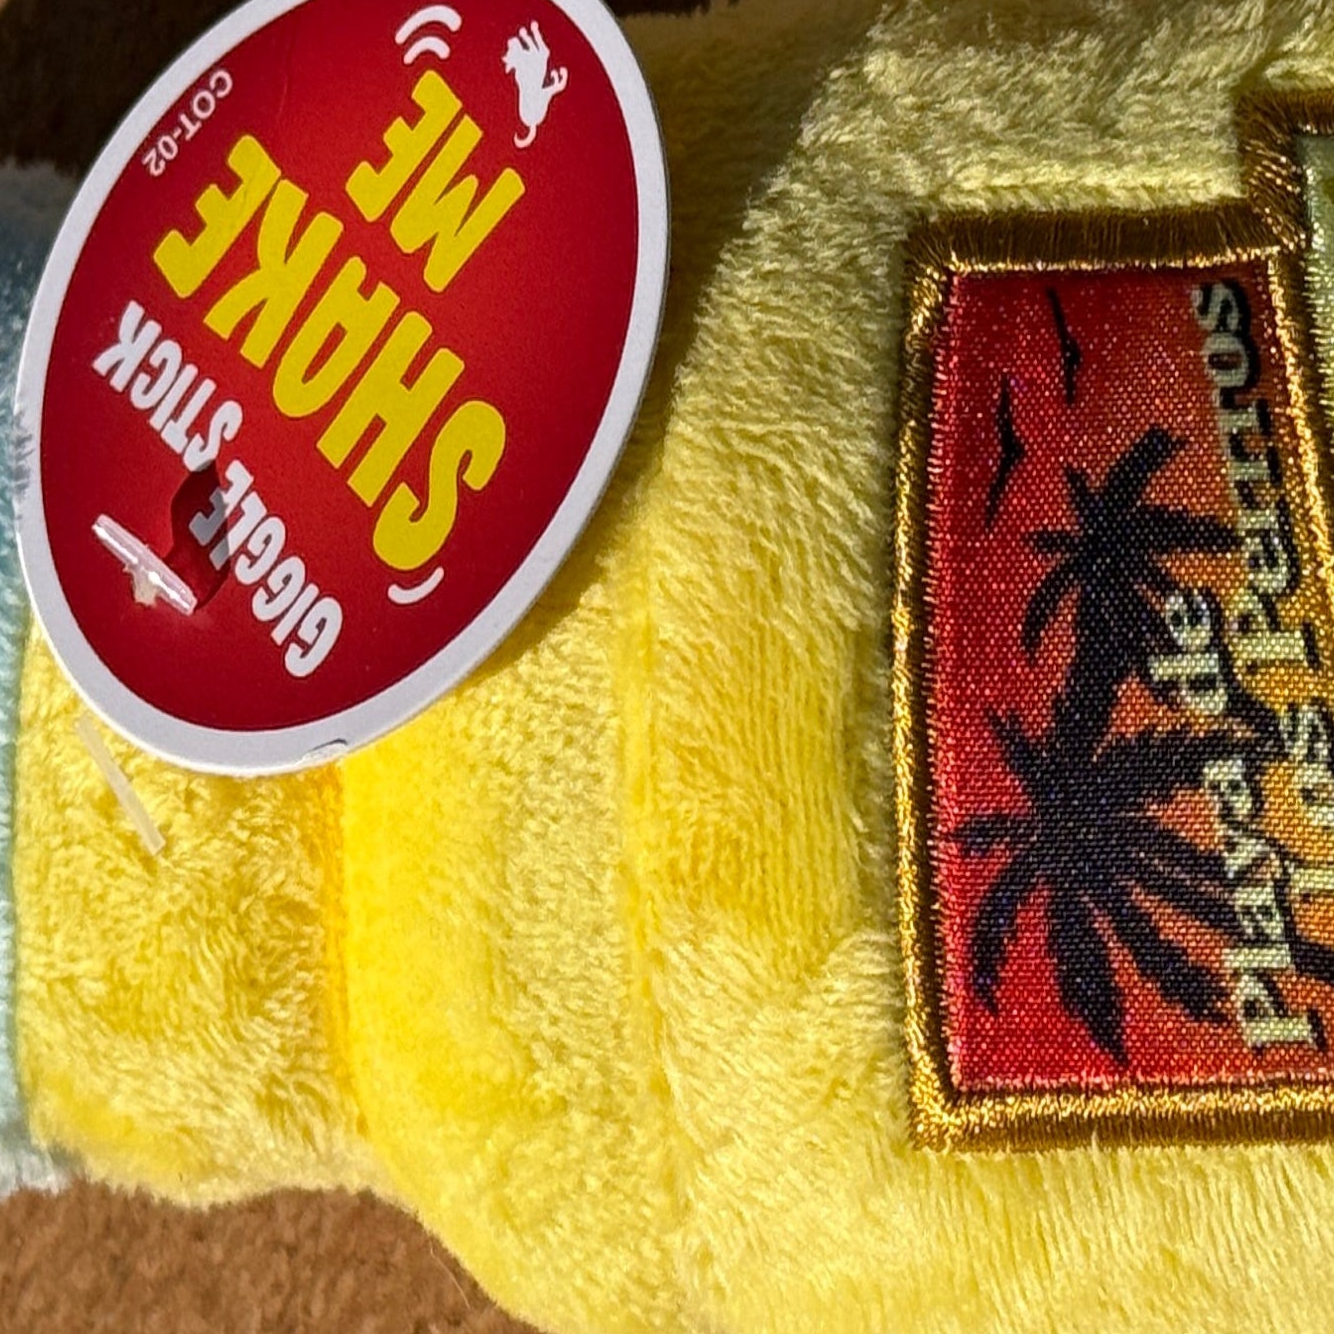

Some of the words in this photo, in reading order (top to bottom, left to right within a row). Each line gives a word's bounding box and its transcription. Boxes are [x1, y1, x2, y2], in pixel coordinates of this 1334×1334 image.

[141, 68, 234, 177] COT-02
[345, 69, 526, 293] ME
[92, 299, 244, 473] STICK
[152, 134, 507, 571] SHAKE
[190, 459, 344, 678] GIGGLE
[1193, 280, 1315, 670] Perros
[1150, 587, 1229, 716] de
[1200, 755, 1319, 1052] Playa
